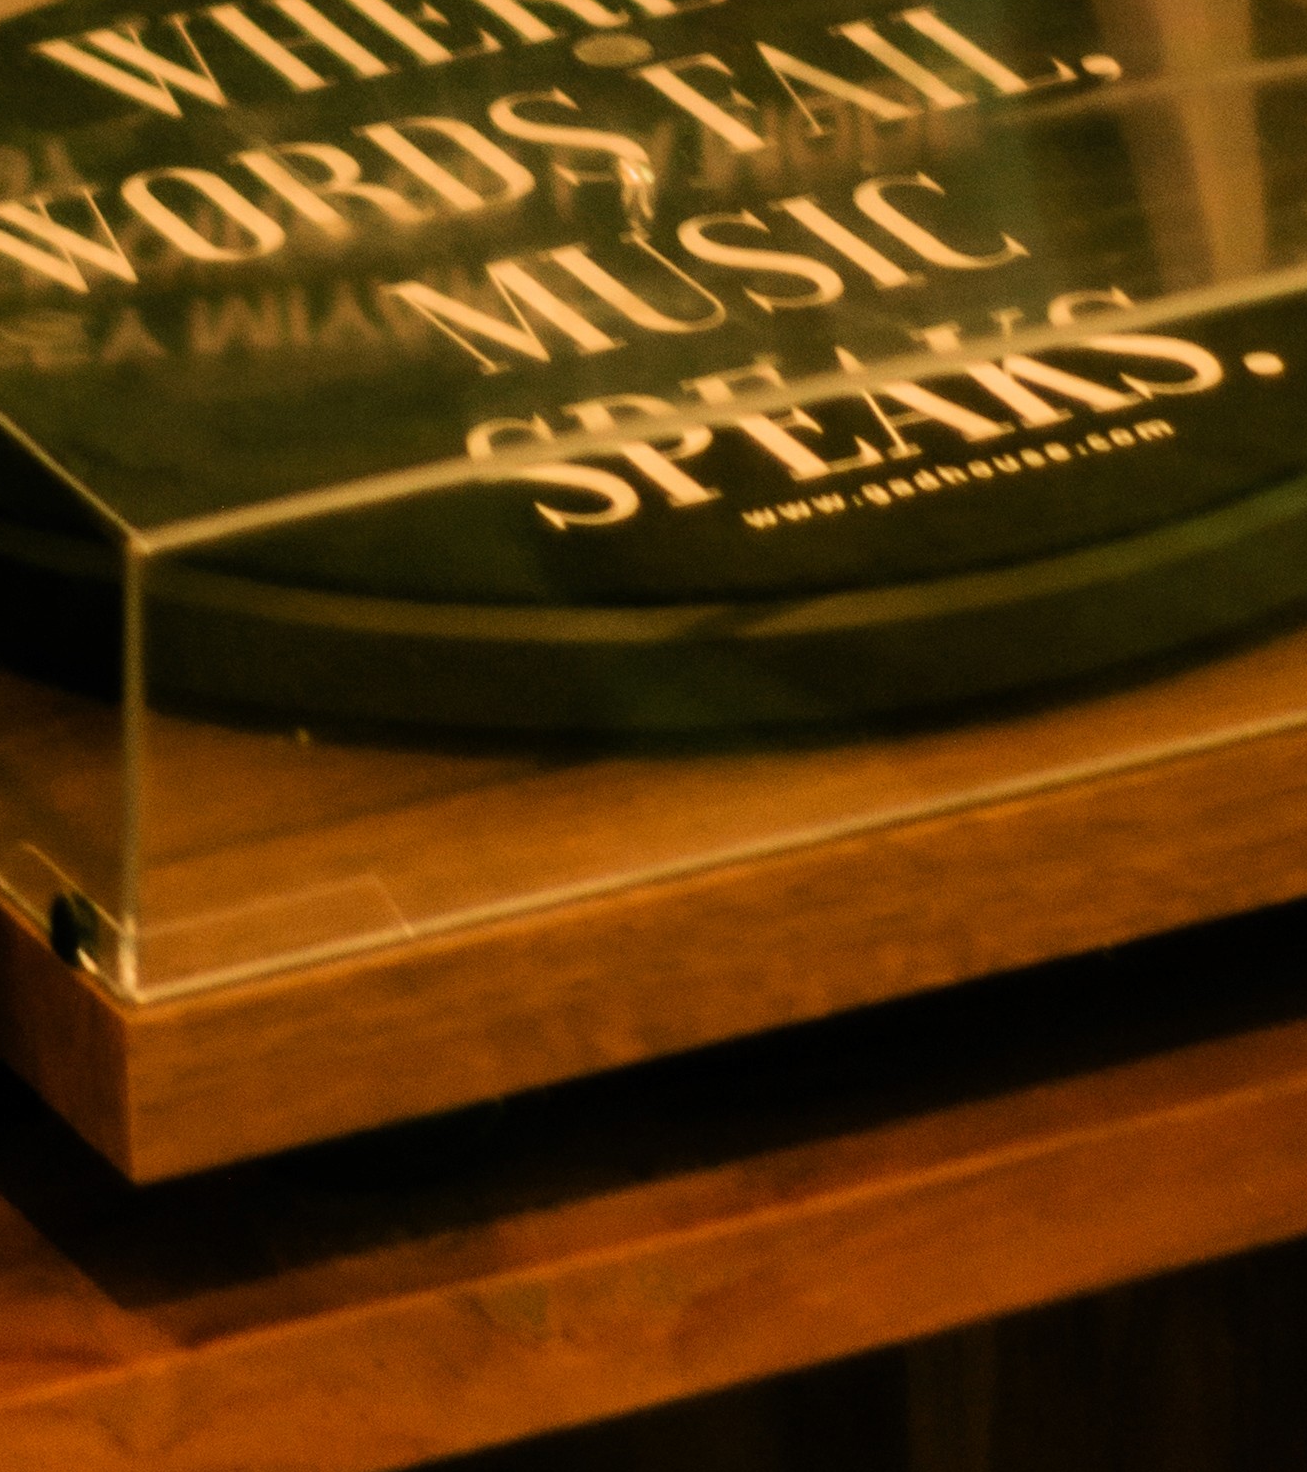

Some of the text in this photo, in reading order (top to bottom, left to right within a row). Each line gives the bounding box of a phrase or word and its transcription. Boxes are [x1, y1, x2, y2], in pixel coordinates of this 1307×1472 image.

[384, 169, 1030, 375] MUSIC
[466, 284, 1285, 532] SPEAKS.
[741, 418, 1176, 530] www.gadhouse.com
